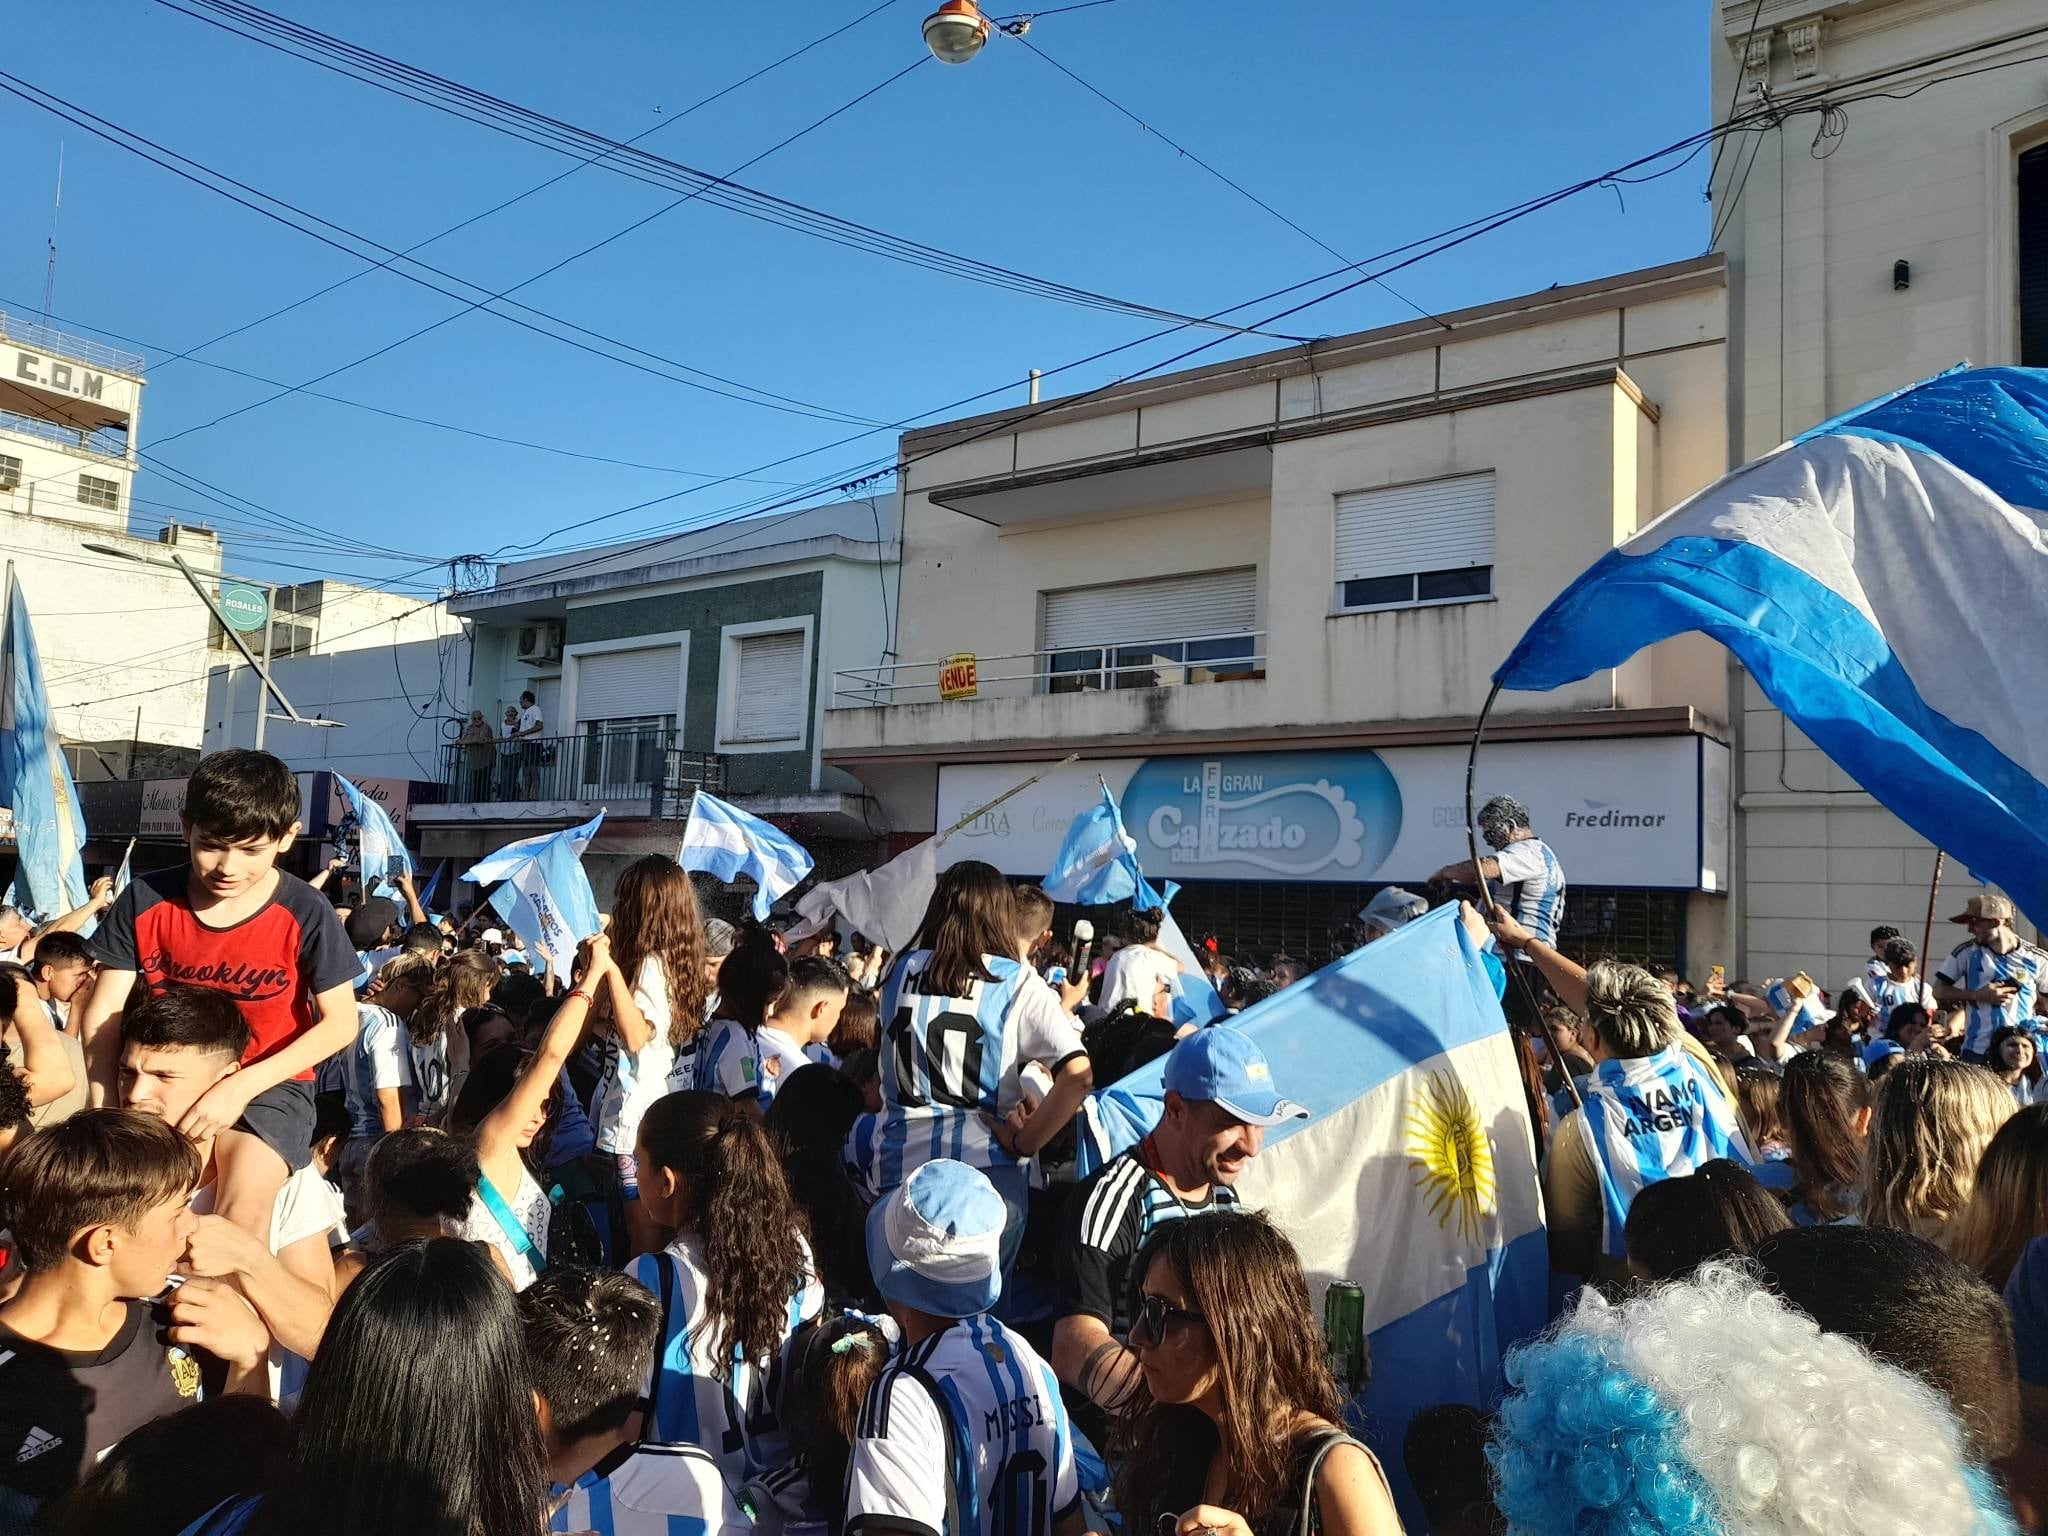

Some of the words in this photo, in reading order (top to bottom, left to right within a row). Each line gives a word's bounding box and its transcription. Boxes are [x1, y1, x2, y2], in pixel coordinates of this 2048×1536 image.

[225, 599, 263, 613] ROSALES
[939, 665, 975, 691] VENDE
[1183, 776, 1200, 793] LA
[1222, 775, 1264, 793] GRAN
[1566, 812, 1666, 828] Fredimar
[1171, 848, 1199, 863] DEL
[142, 948, 290, 994] Brooklyn
[886, 1006, 985, 1108] 10
[420, 1058, 443, 1102] 10
[1624, 1107, 1694, 1137] ARGEN
[984, 1394, 1043, 1442] MESSI
[16, 1437, 62, 1462] adidas
